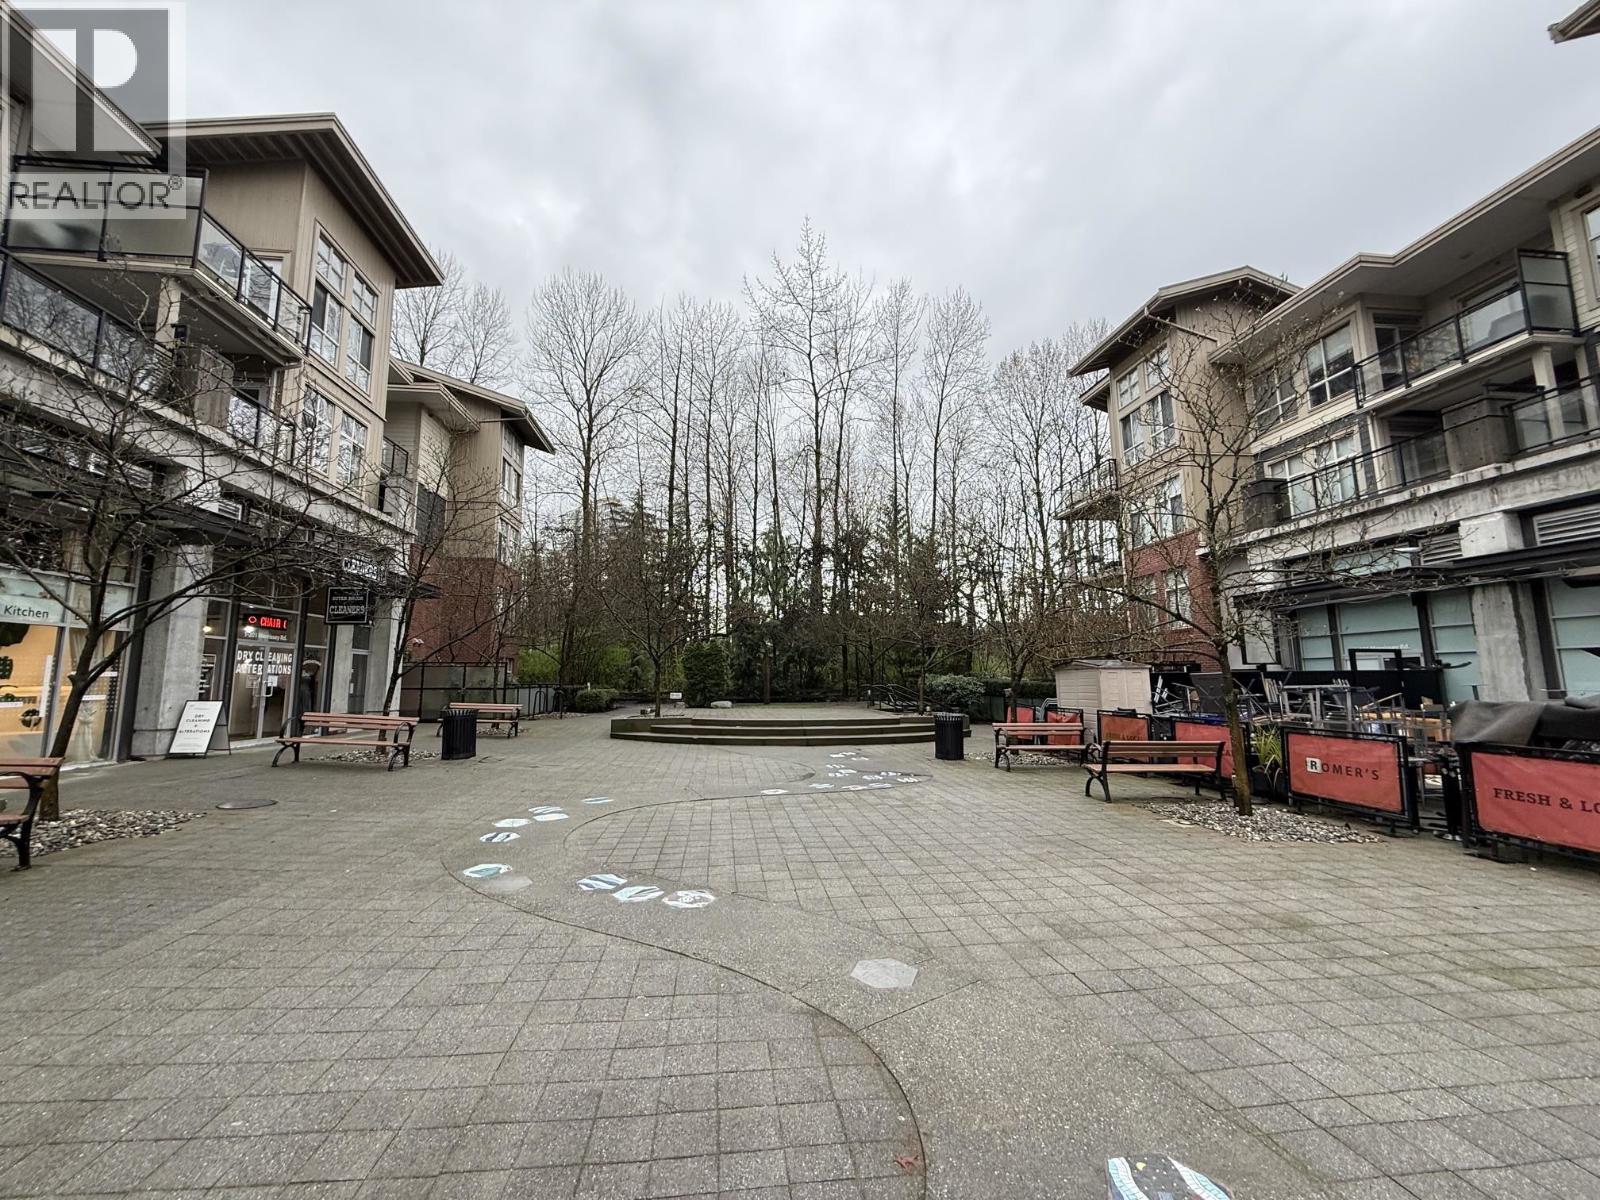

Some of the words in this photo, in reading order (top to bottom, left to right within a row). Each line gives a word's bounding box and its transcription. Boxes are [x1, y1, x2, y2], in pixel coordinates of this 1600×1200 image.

[4, 605, 49, 618] Kitchen
[330, 605, 365, 614] CLEANERS
[237, 650, 254, 661] DRY
[1309, 760, 1380, 781] ROMER'S
[1493, 787, 1553, 807] FRESH
[1559, 797, 1573, 810] &
